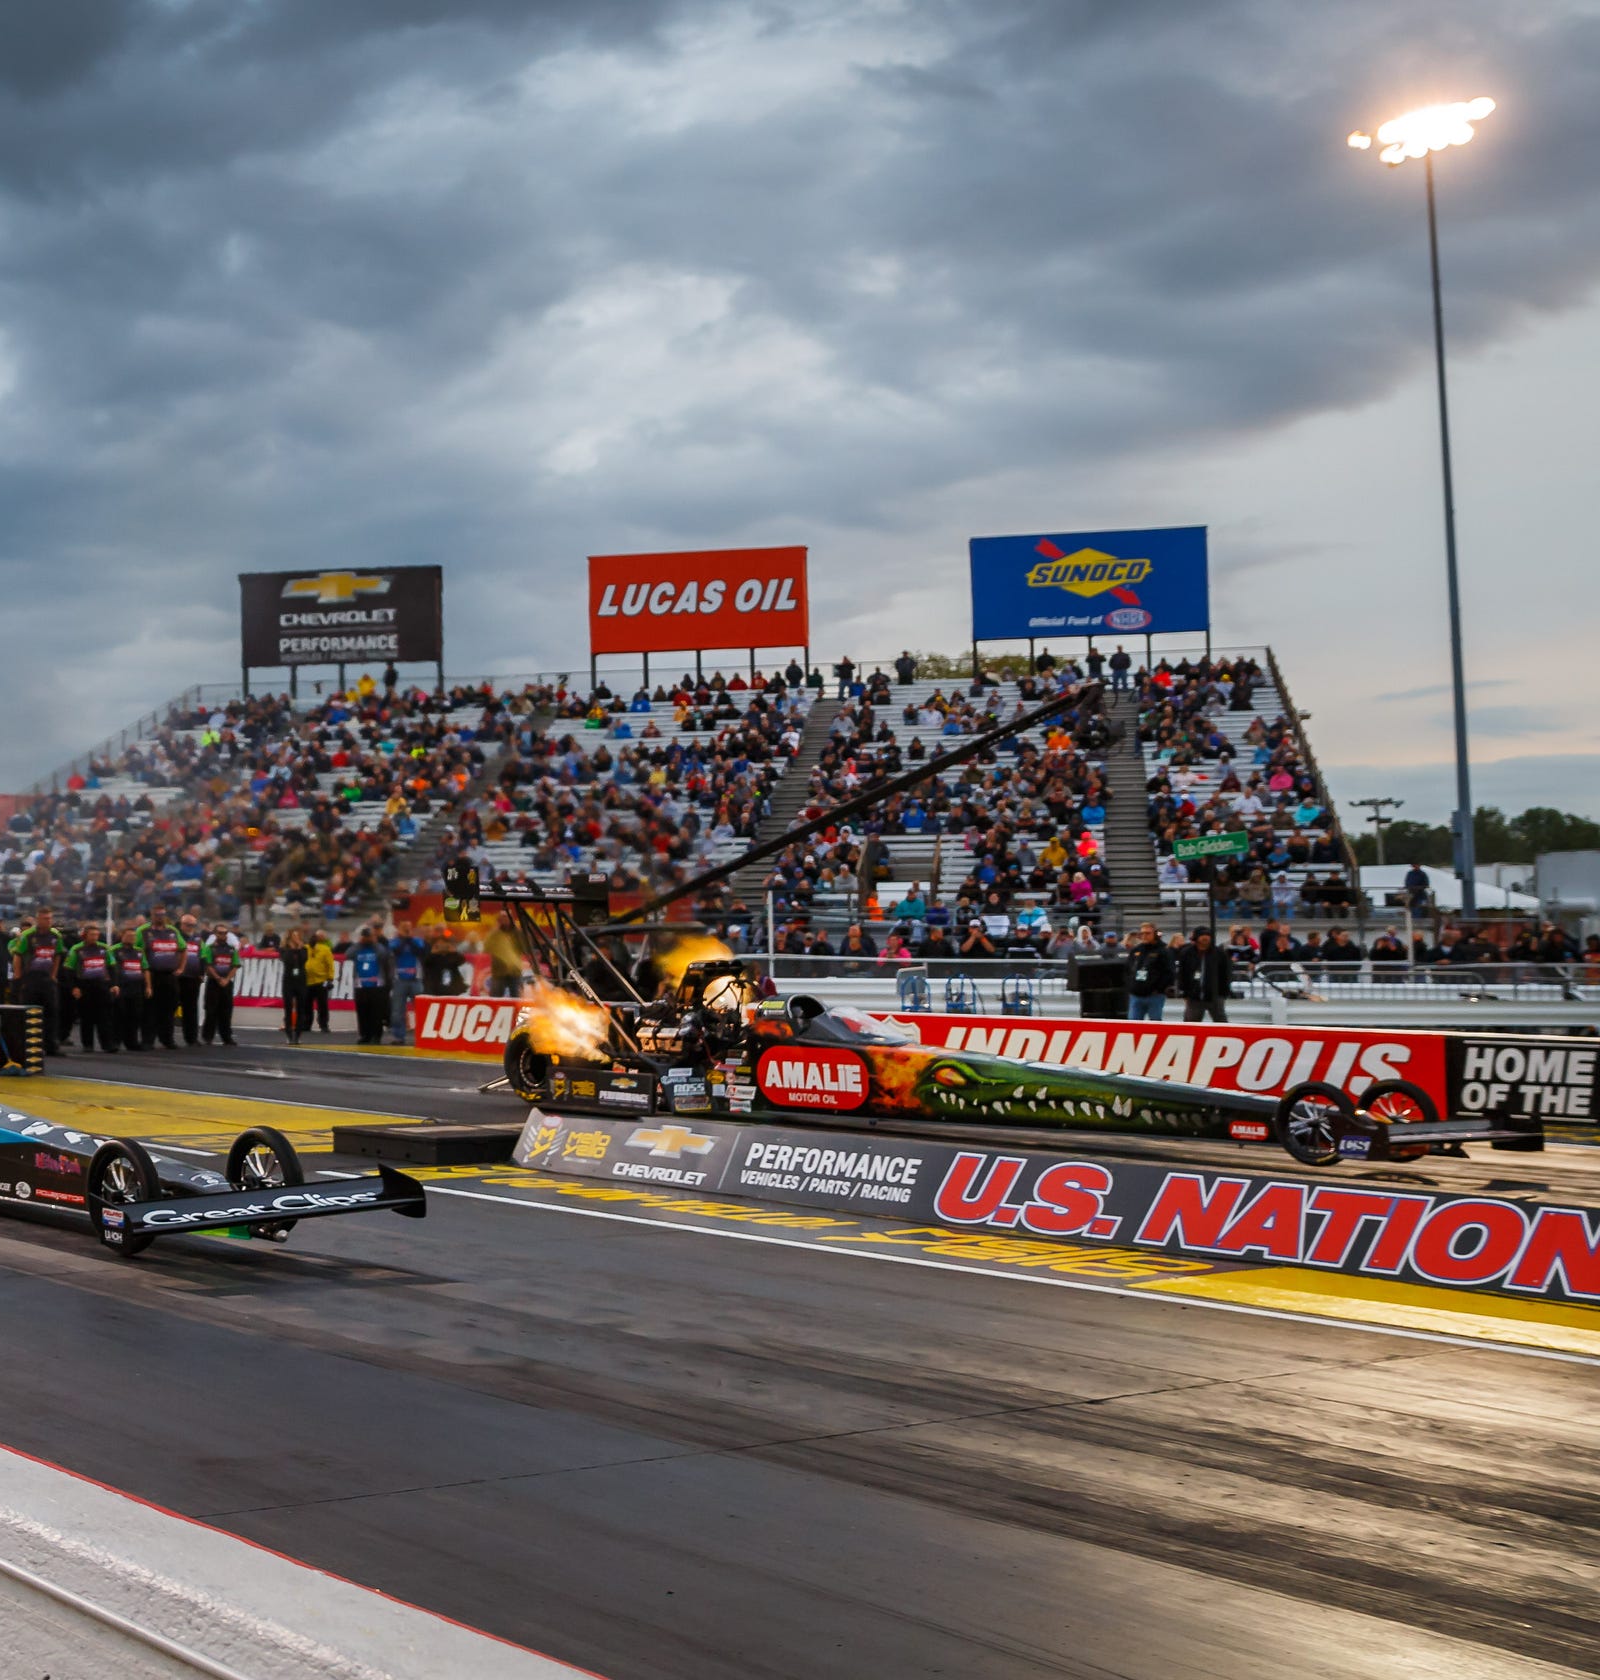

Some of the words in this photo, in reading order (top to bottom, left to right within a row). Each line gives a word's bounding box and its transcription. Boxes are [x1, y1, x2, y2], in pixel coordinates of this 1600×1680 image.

[1033, 562, 1146, 583] SUNOCO
[597, 579, 727, 616] LUCAS
[734, 578, 798, 613] OIL
[279, 608, 397, 627] CHEVROLET
[279, 634, 398, 652] PERFORMANCE
[421, 1002, 516, 1043] LUCA
[765, 1060, 863, 1093] AMALIE
[1463, 1047, 1597, 1085] HOME
[788, 1092, 821, 1104] MOTOR
[823, 1093, 838, 1105] OIL
[1461, 1081, 1511, 1110] OF
[1518, 1084, 1594, 1115] THE
[612, 1162, 708, 1186] CHEVROLET
[744, 1142, 924, 1185] PERFORMANCE
[740, 1170, 800, 1190] VEHICLES
[808, 1177, 852, 1196] PARTS
[857, 1184, 913, 1204] RACING
[933, 1152, 1123, 1240] U.S.
[143, 1203, 281, 1226] Great
[271, 1192, 377, 1211] Clips
